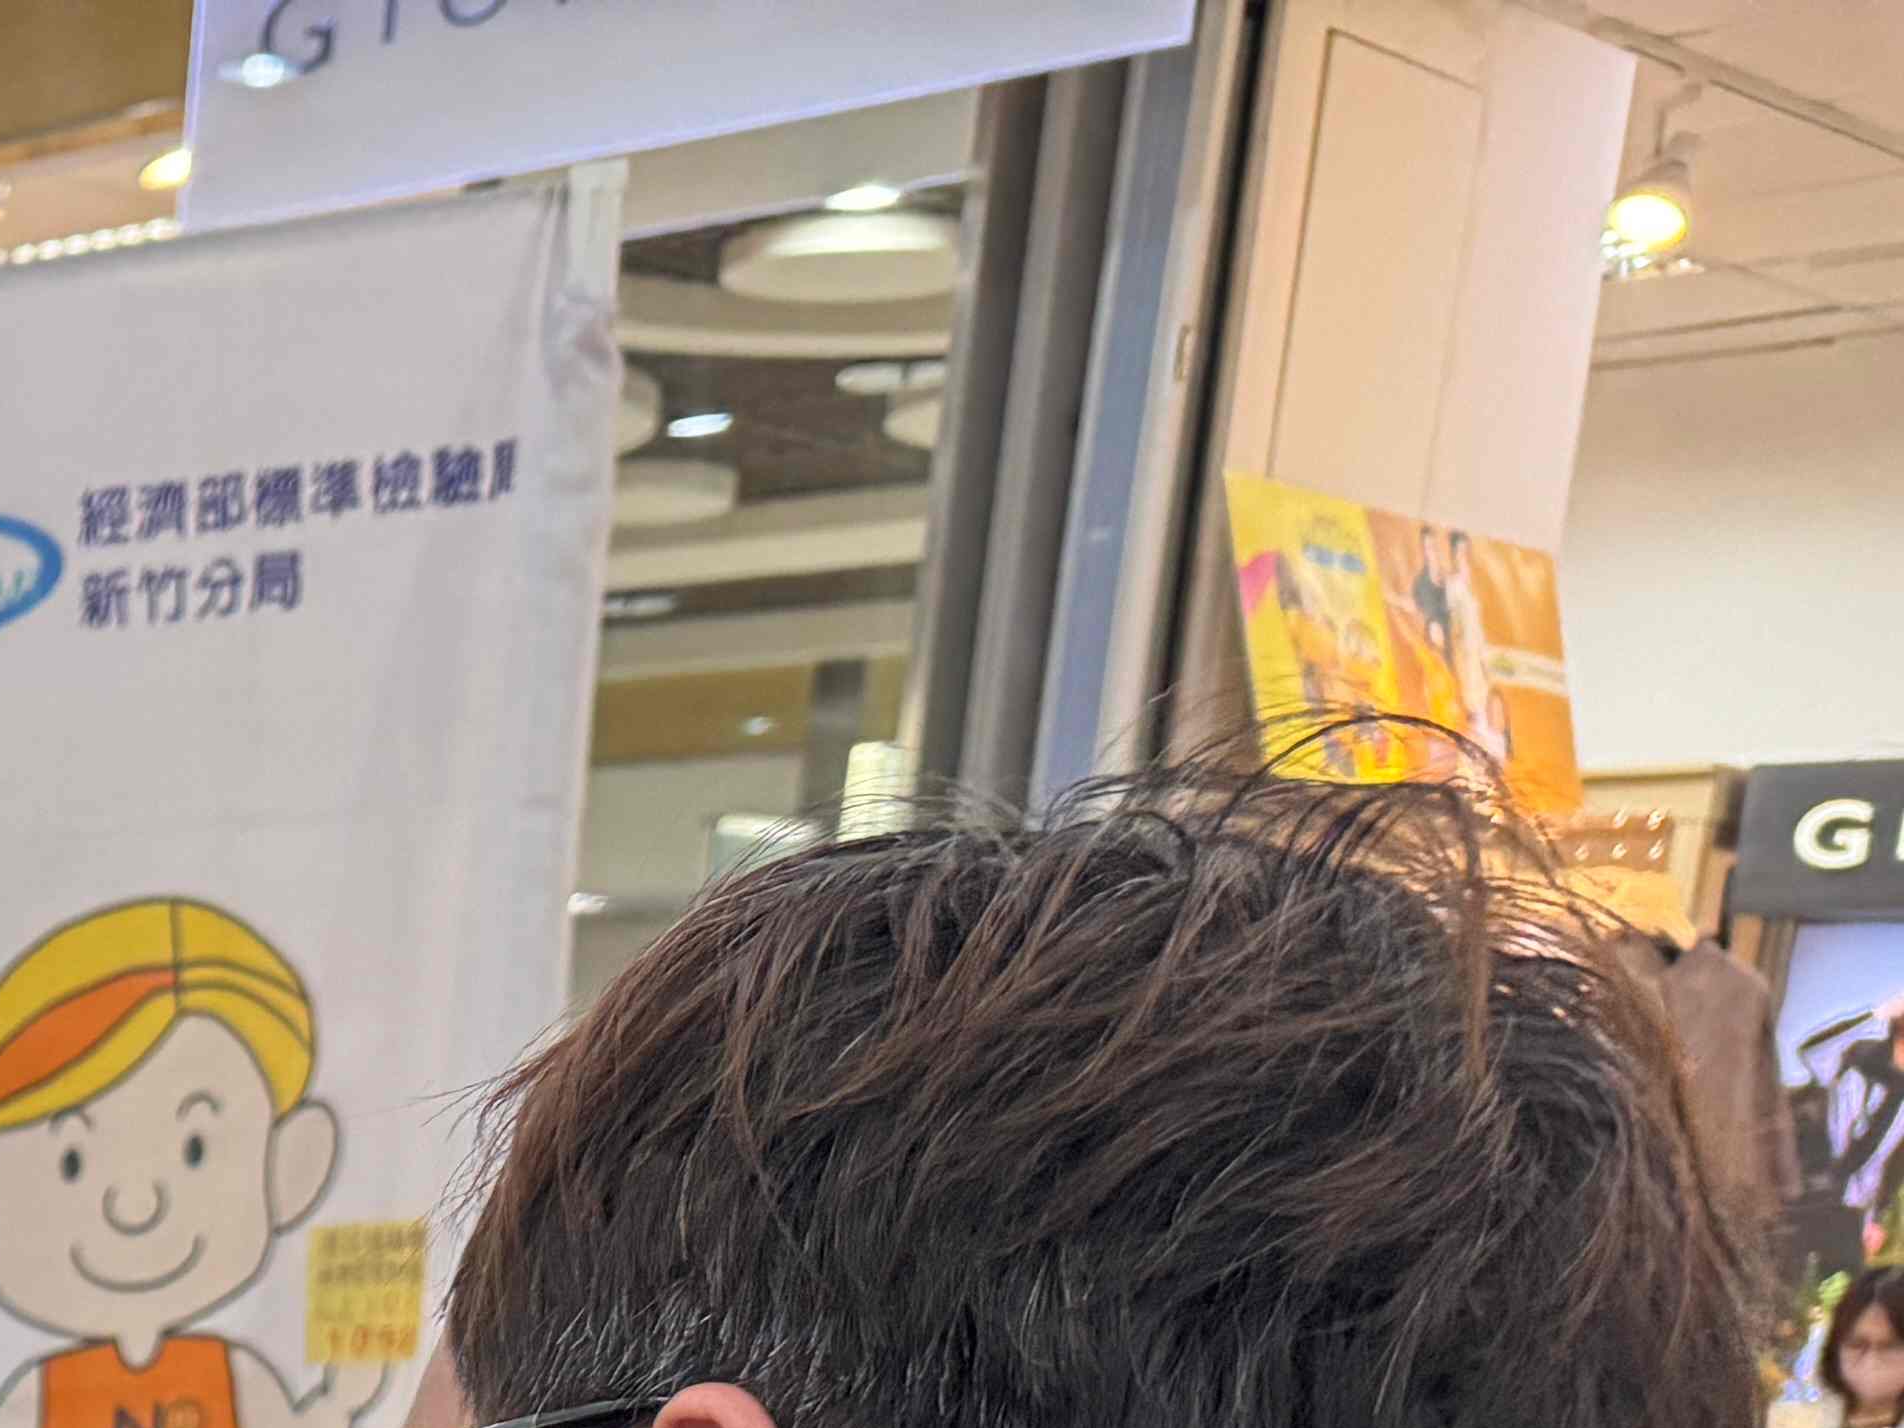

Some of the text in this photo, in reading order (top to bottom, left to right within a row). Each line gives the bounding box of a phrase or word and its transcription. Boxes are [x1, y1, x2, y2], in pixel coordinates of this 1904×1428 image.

[78, 548, 303, 630] 新竹分局
[1793, 798, 1904, 869] G
